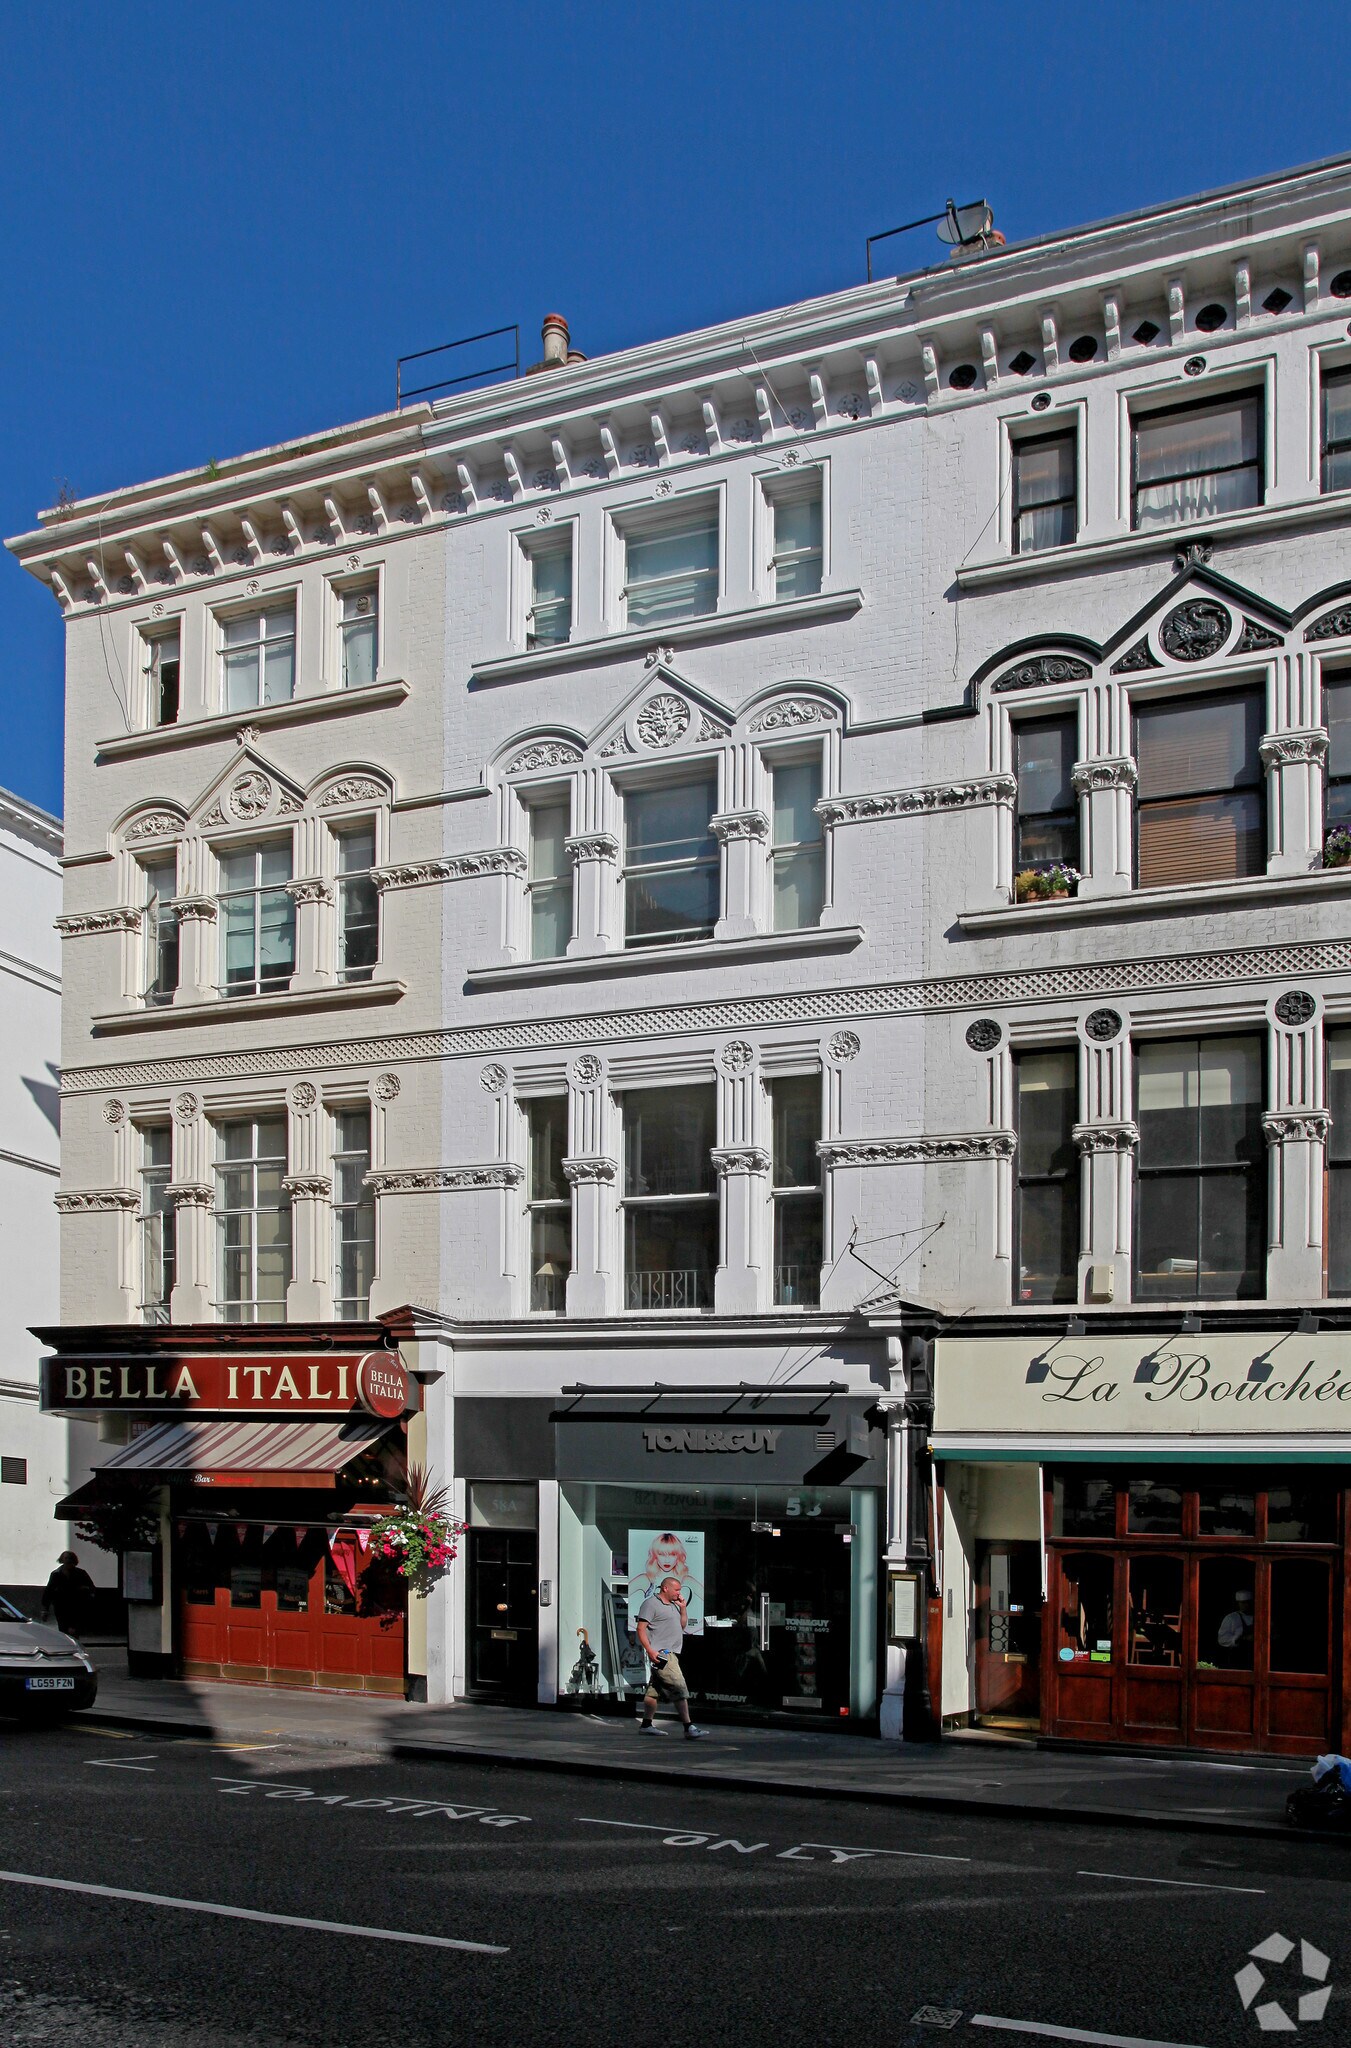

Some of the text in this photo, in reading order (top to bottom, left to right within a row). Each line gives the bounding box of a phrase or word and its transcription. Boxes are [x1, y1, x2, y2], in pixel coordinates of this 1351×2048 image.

[65, 1365, 357, 1400] BELLA ITALI
[370, 1369, 403, 1388] BELLA
[1042, 1352, 1351, 1402] La Bouchée
[369, 1382, 405, 1401] ITALIA
[643, 1428, 783, 1453] TONI&GUY
[194, 1473, 211, 1483] Bar
[785, 1618, 830, 1628] TONI&GUY
[31, 1678, 73, 1688] LG59 FZN
[705, 1692, 748, 1703] TONI&GUY
[218, 1785, 876, 1864] LOADING ONLY
